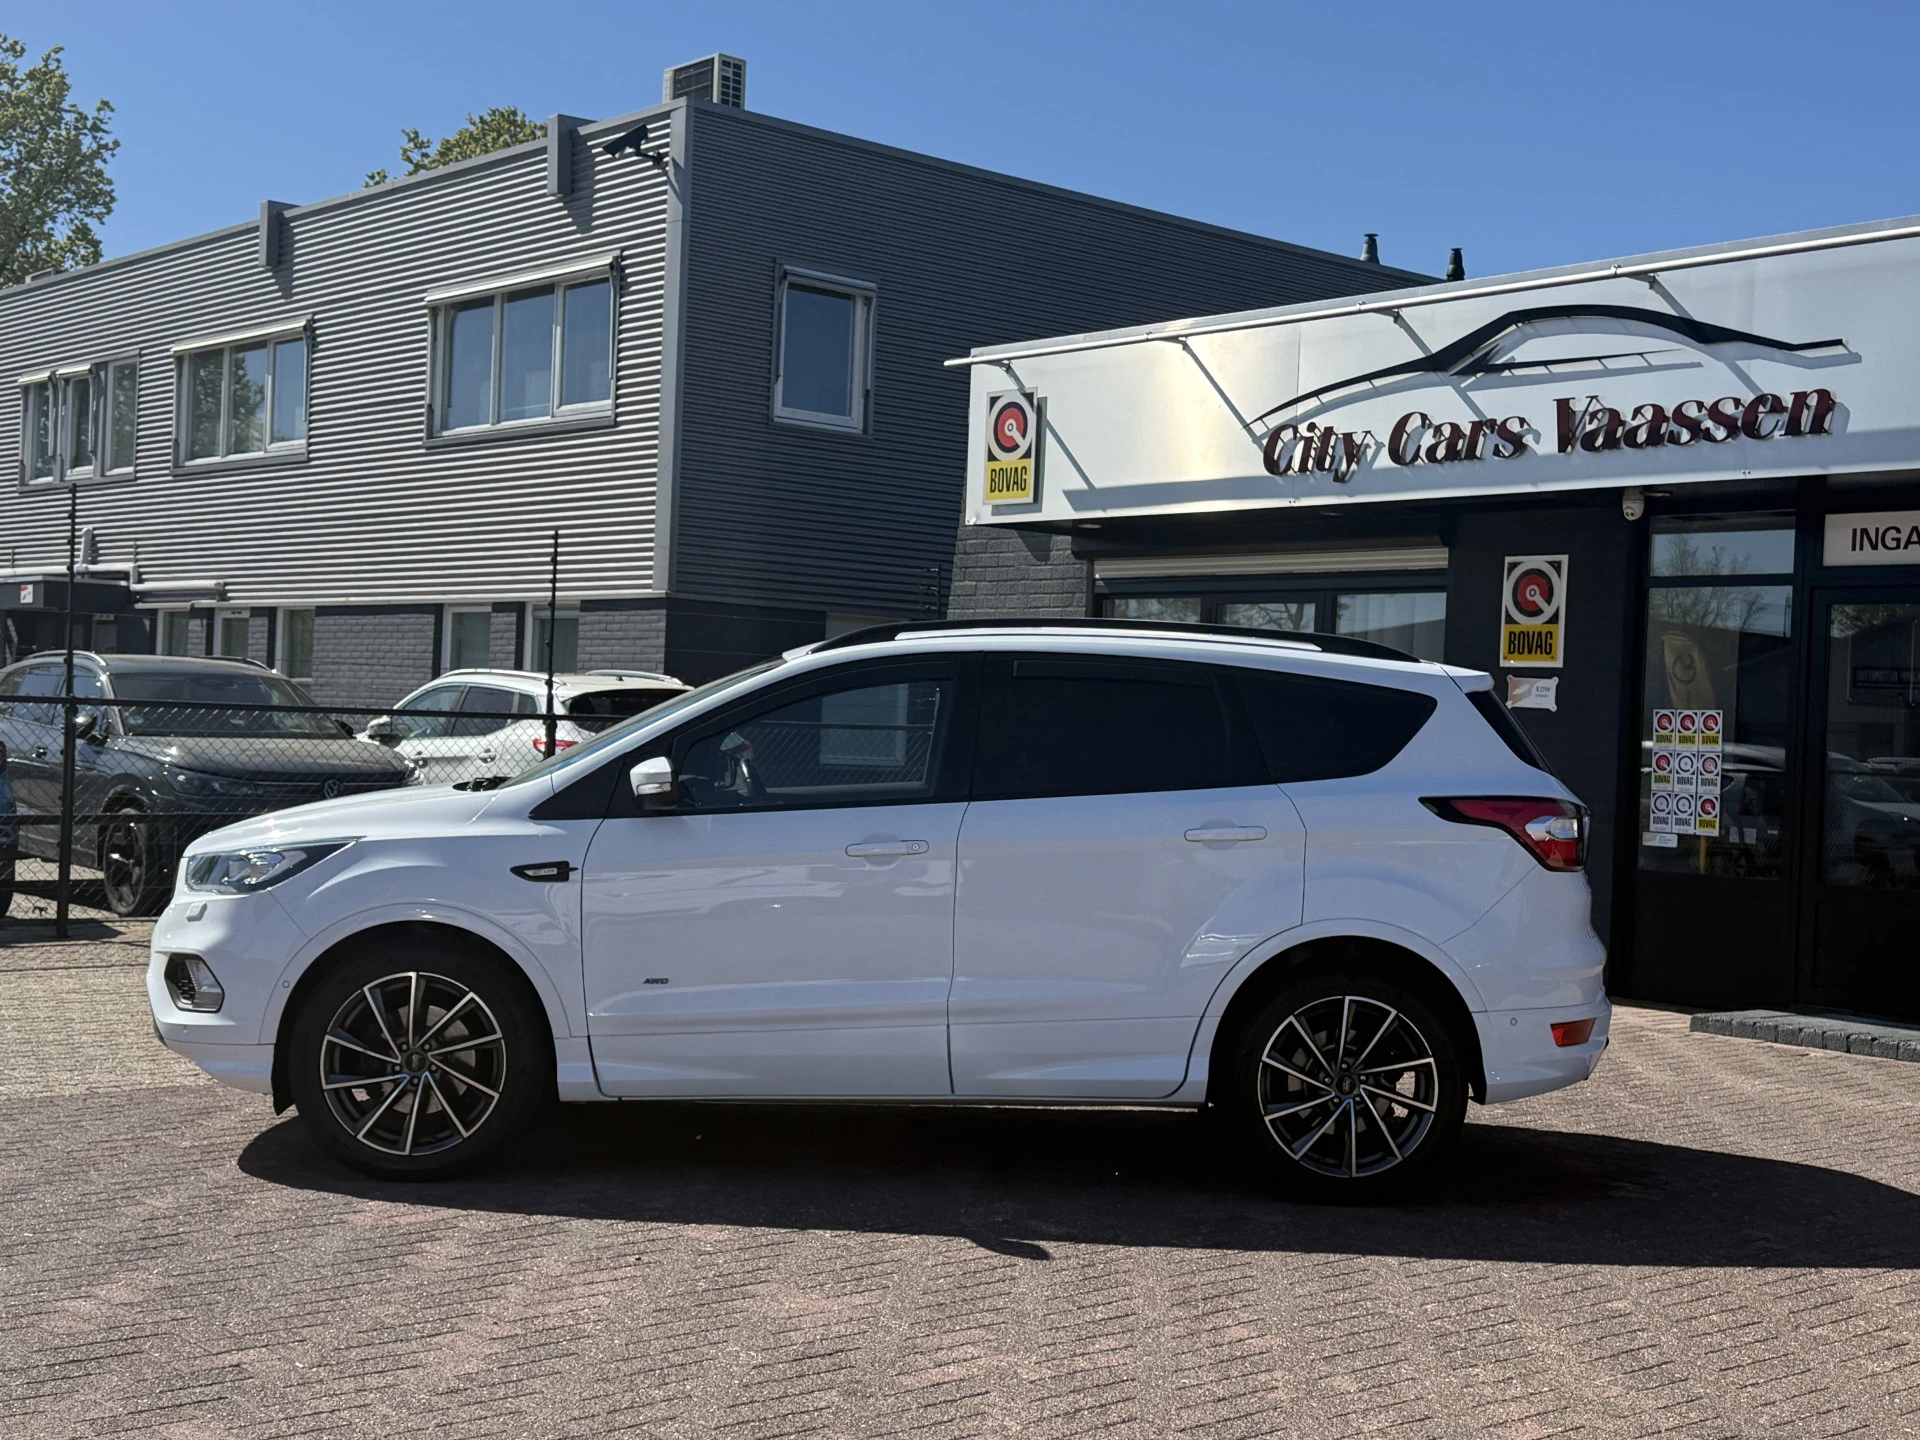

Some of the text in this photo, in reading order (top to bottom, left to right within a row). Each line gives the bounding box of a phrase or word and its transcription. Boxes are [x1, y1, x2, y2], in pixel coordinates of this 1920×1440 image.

[1263, 388, 1834, 484] City Cars Vaassen
[990, 466, 1027, 493] BOVAG
[1851, 525, 1920, 552] INGA
[1508, 631, 1553, 655] BOVAG
[1656, 734, 1673, 744] BOVAG
[1678, 735, 1696, 745] BOVAG
[1701, 735, 1719, 745] BOVAG
[1654, 773, 1671, 784] BOVAG
[1677, 776, 1694, 786] BOVAG
[1700, 778, 1718, 788] BOVAG
[1653, 815, 1669, 825] BOVAG
[1674, 817, 1692, 827] BOVAG
[1698, 819, 1716, 829] BOVAG
[643, 977, 669, 985] AWD
